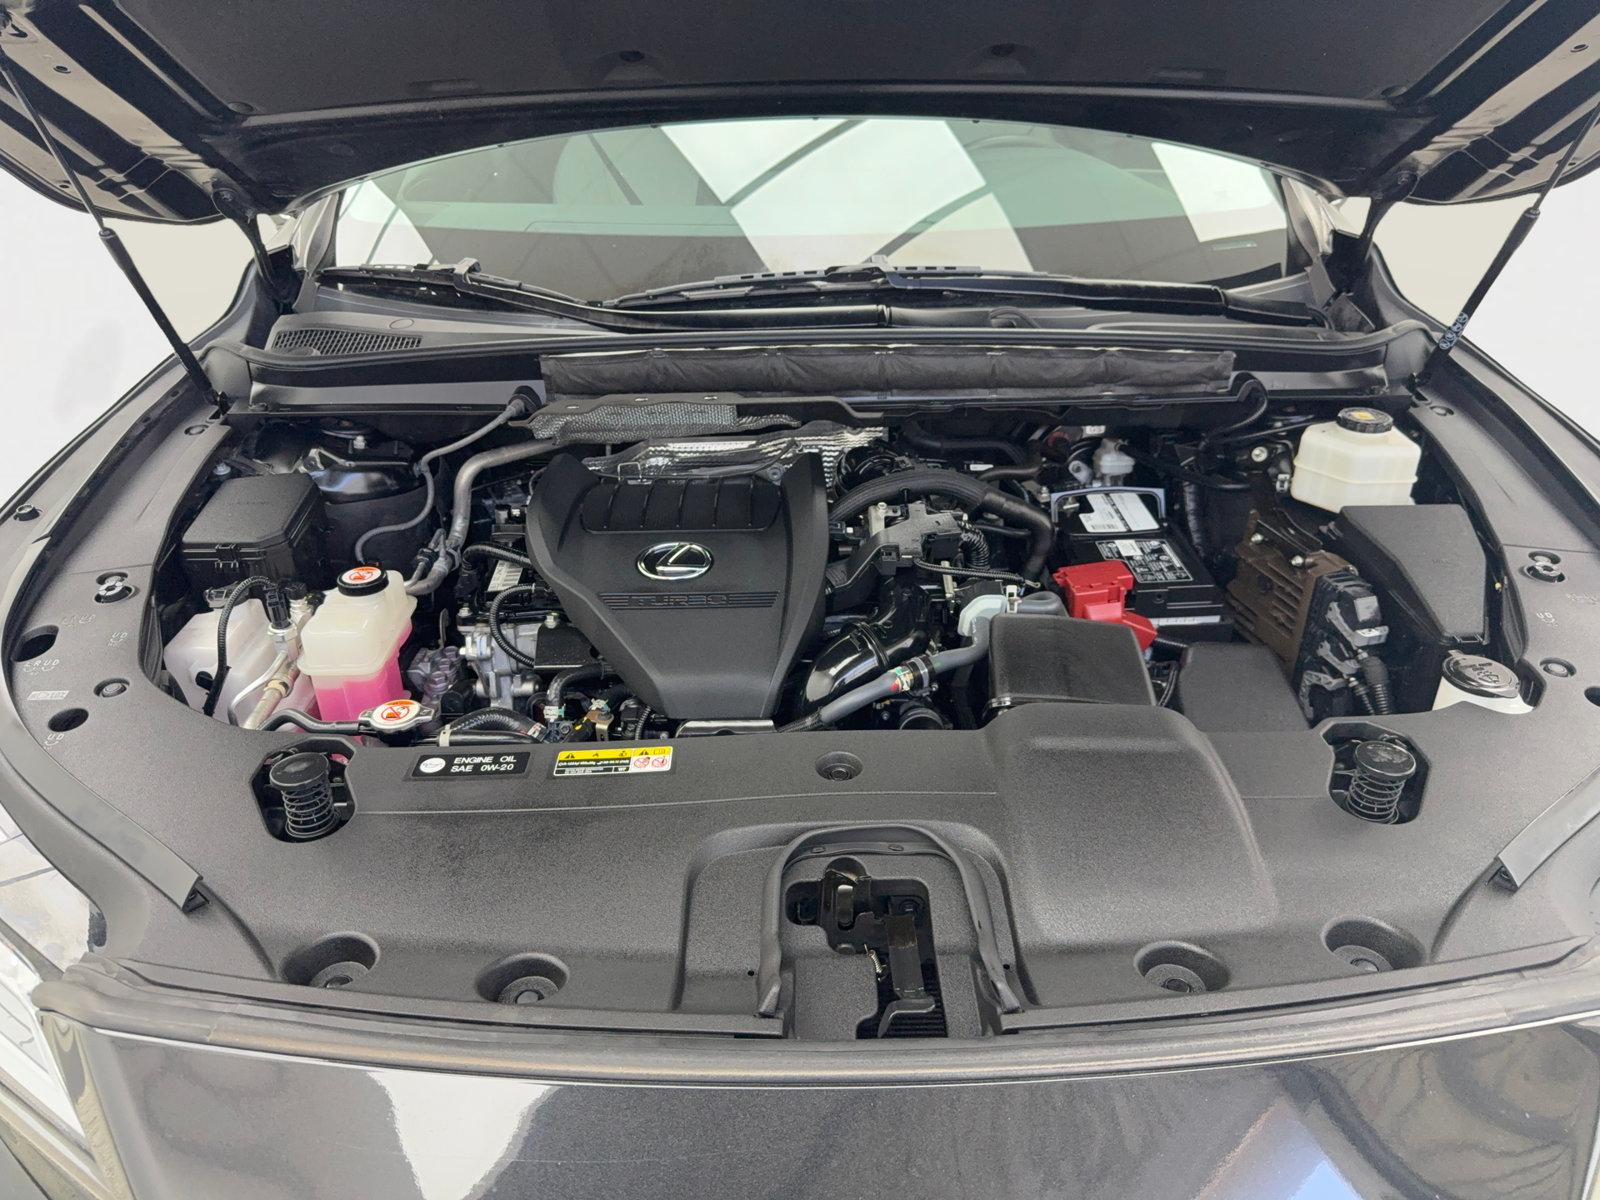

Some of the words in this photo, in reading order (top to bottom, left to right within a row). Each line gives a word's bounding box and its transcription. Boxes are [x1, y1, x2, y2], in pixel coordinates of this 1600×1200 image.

[631, 594, 727, 606] TURBO
[453, 756, 494, 765] ENGINE
[499, 755, 517, 763] OIL
[450, 764, 474, 773] SAE
[480, 763, 515, 772] 0W-20
